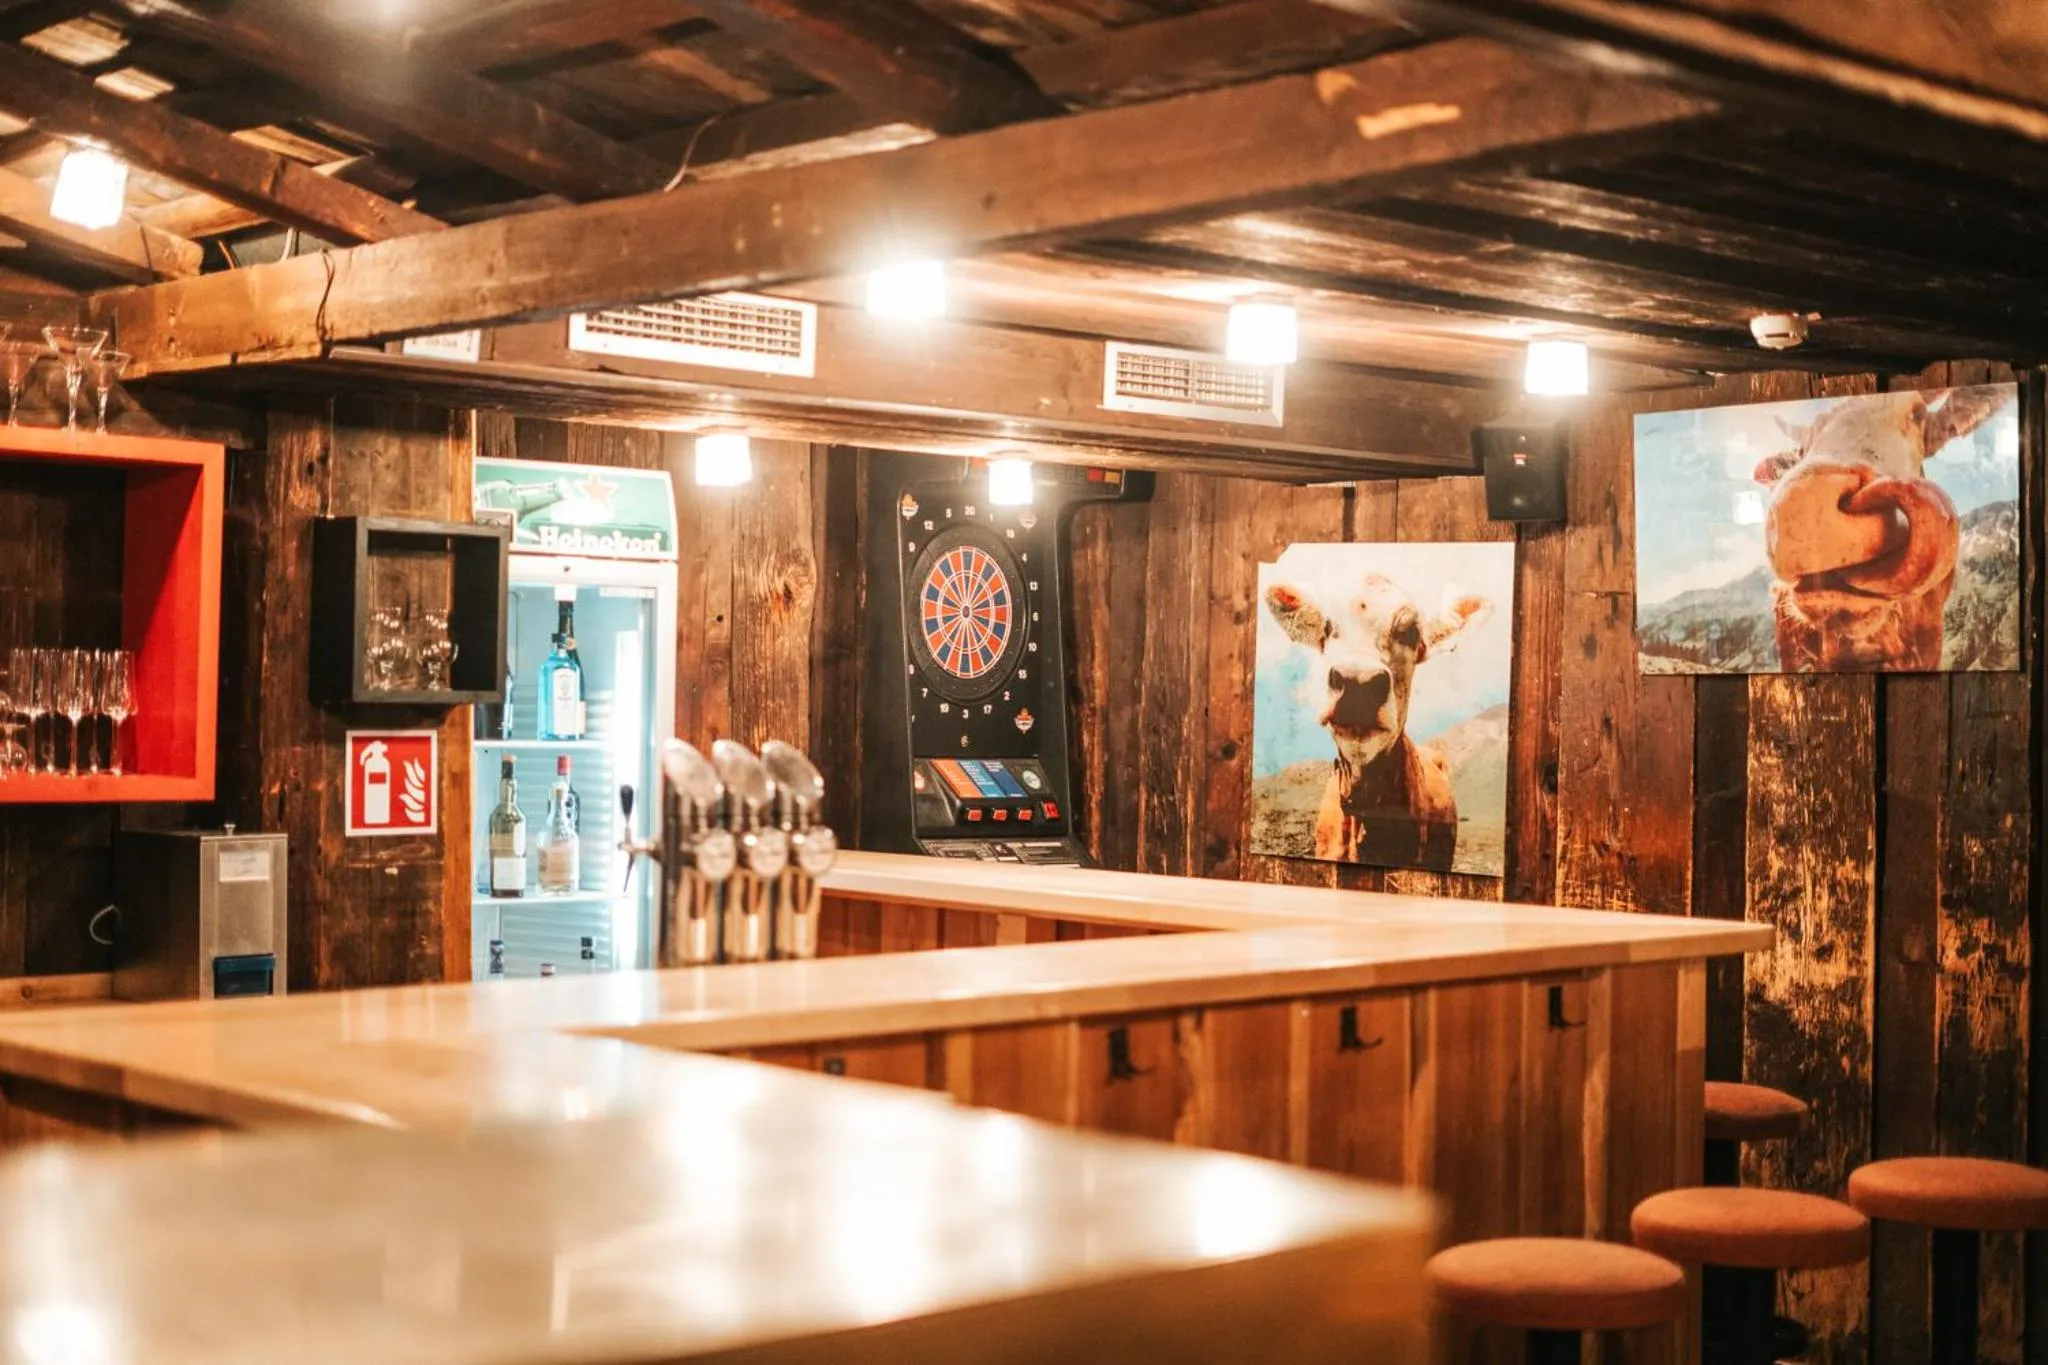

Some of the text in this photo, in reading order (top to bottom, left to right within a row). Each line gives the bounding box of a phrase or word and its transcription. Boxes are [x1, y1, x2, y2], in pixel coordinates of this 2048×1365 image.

[964, 505, 976, 516] 20
[923, 519, 935, 531] 12
[538, 525, 662, 553] Heineken
[1033, 611, 1040, 622] 6
[1017, 669, 1028, 680] 15
[921, 687, 929, 698] 7
[1003, 690, 1010, 701] 2
[962, 708, 969, 719] 3
[983, 704, 993, 714] 17
